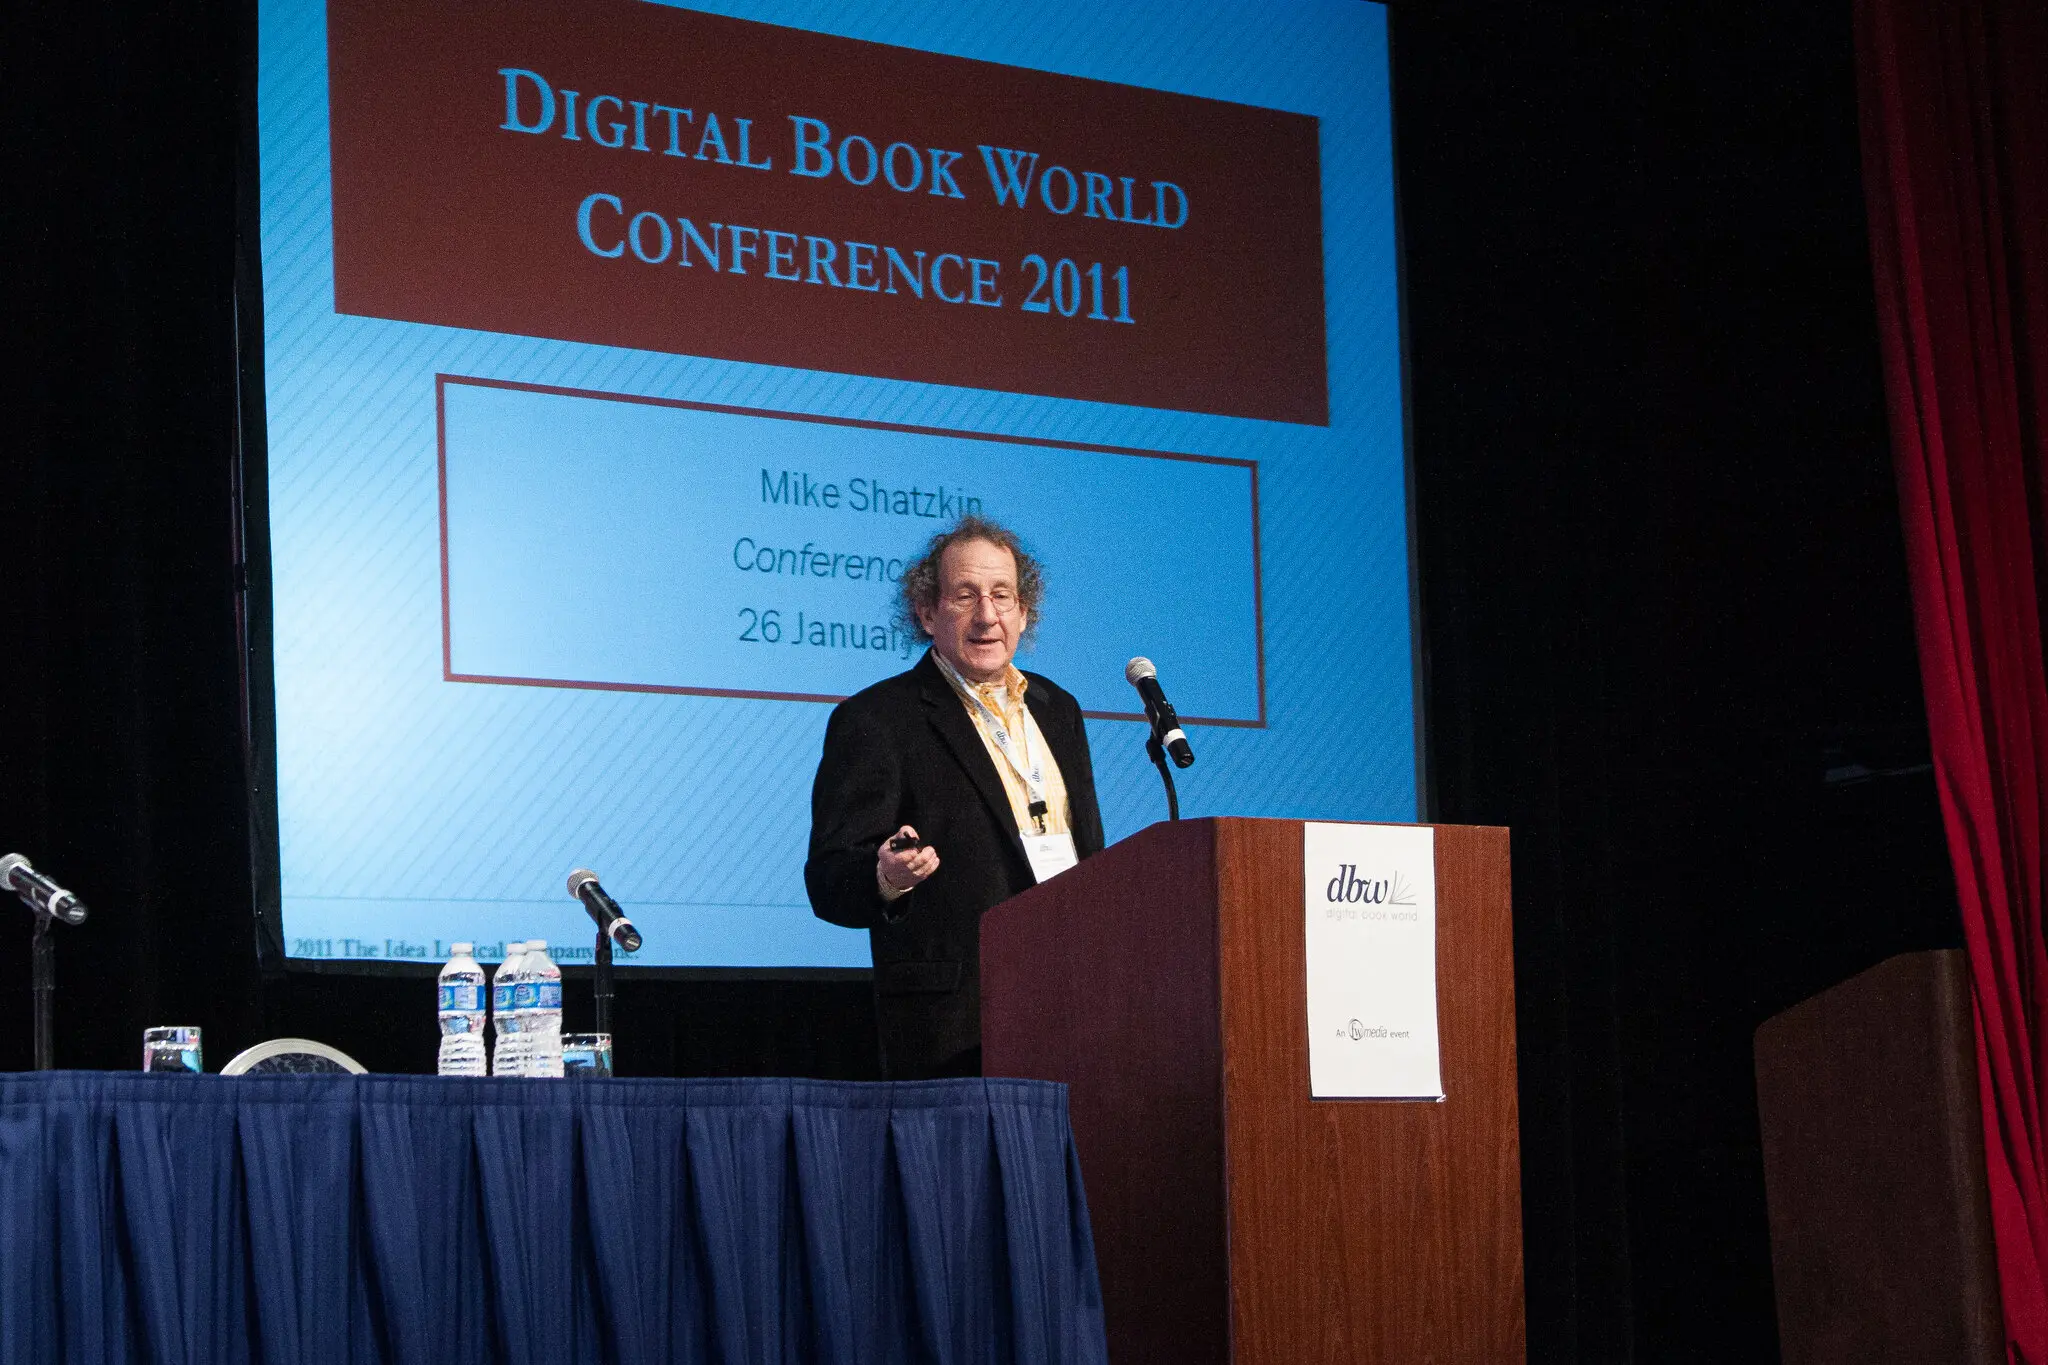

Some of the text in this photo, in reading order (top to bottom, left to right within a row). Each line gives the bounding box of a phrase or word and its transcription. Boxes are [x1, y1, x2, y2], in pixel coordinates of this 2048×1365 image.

[498, 67, 1190, 229] DIGITAL BOOK WORLD
[576, 192, 1136, 325] CONFERENCE 2011
[760, 467, 983, 518] Mike Shatzkin
[733, 536, 903, 583] Conferenc
[737, 607, 782, 644] 26
[1326, 864, 1389, 904] dbw
[1391, 908, 1418, 922] world
[292, 938, 332, 957] 2011
[335, 938, 379, 958] The
[383, 938, 427, 958] Idea
[1335, 1028, 1346, 1037] An
[1389, 1030, 1410, 1038] event
